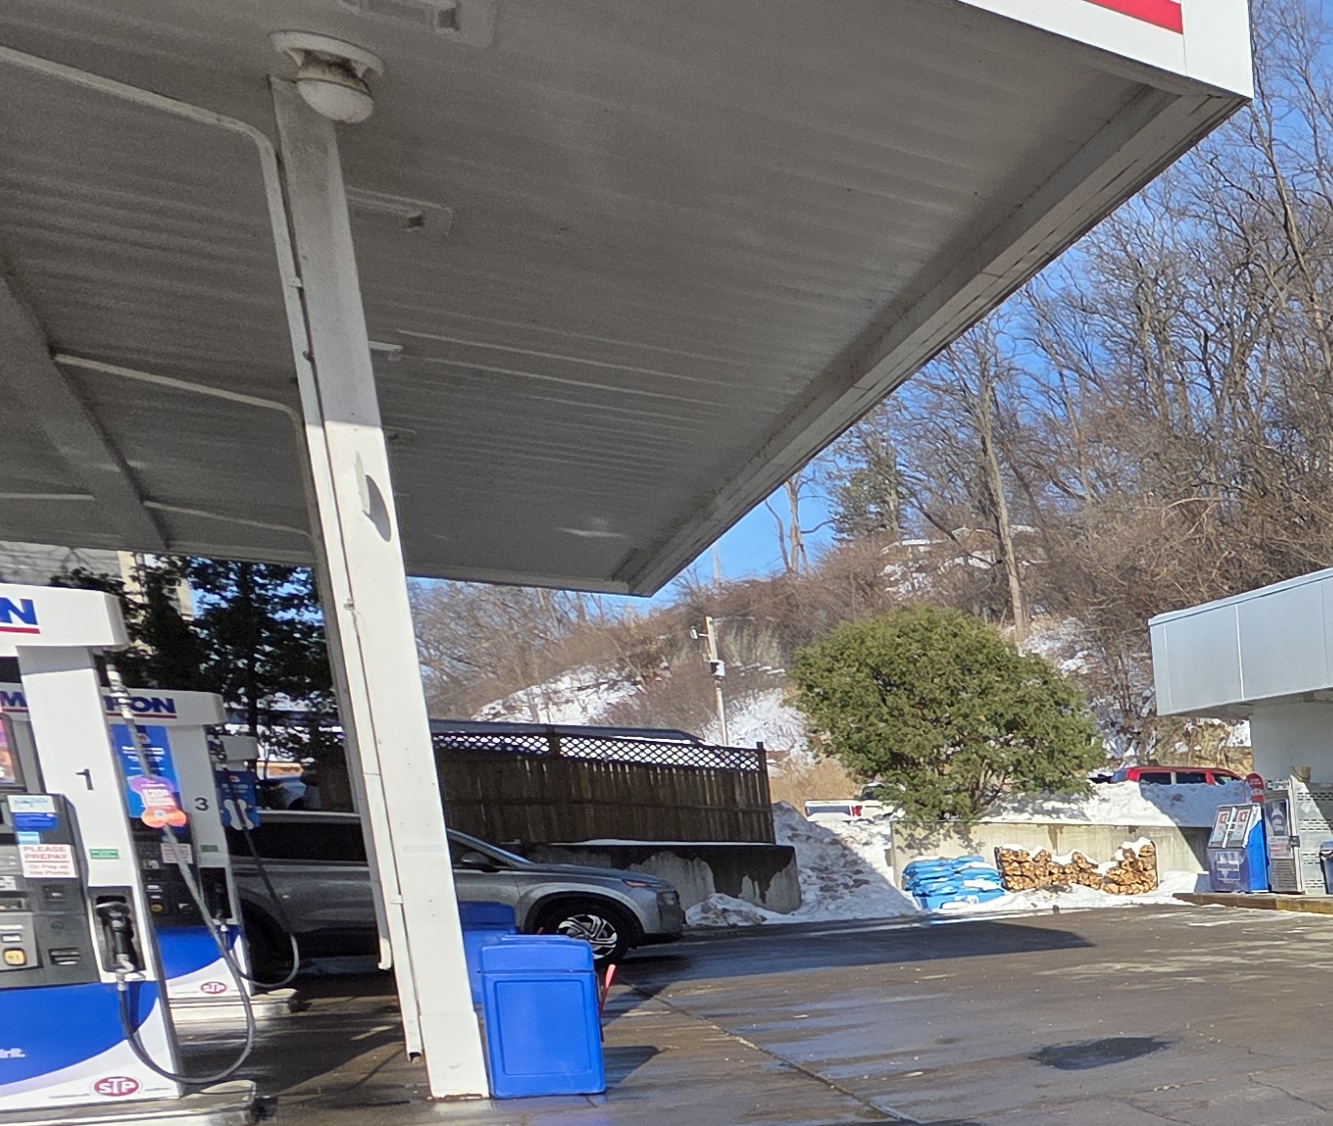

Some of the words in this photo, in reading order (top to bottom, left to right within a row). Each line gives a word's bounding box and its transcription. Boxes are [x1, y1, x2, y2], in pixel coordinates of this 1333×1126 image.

[76, 768, 94, 791] 1
[195, 797, 209, 811] 3
[203, 982, 226, 993] STP
[98, 1077, 136, 1095] STP
